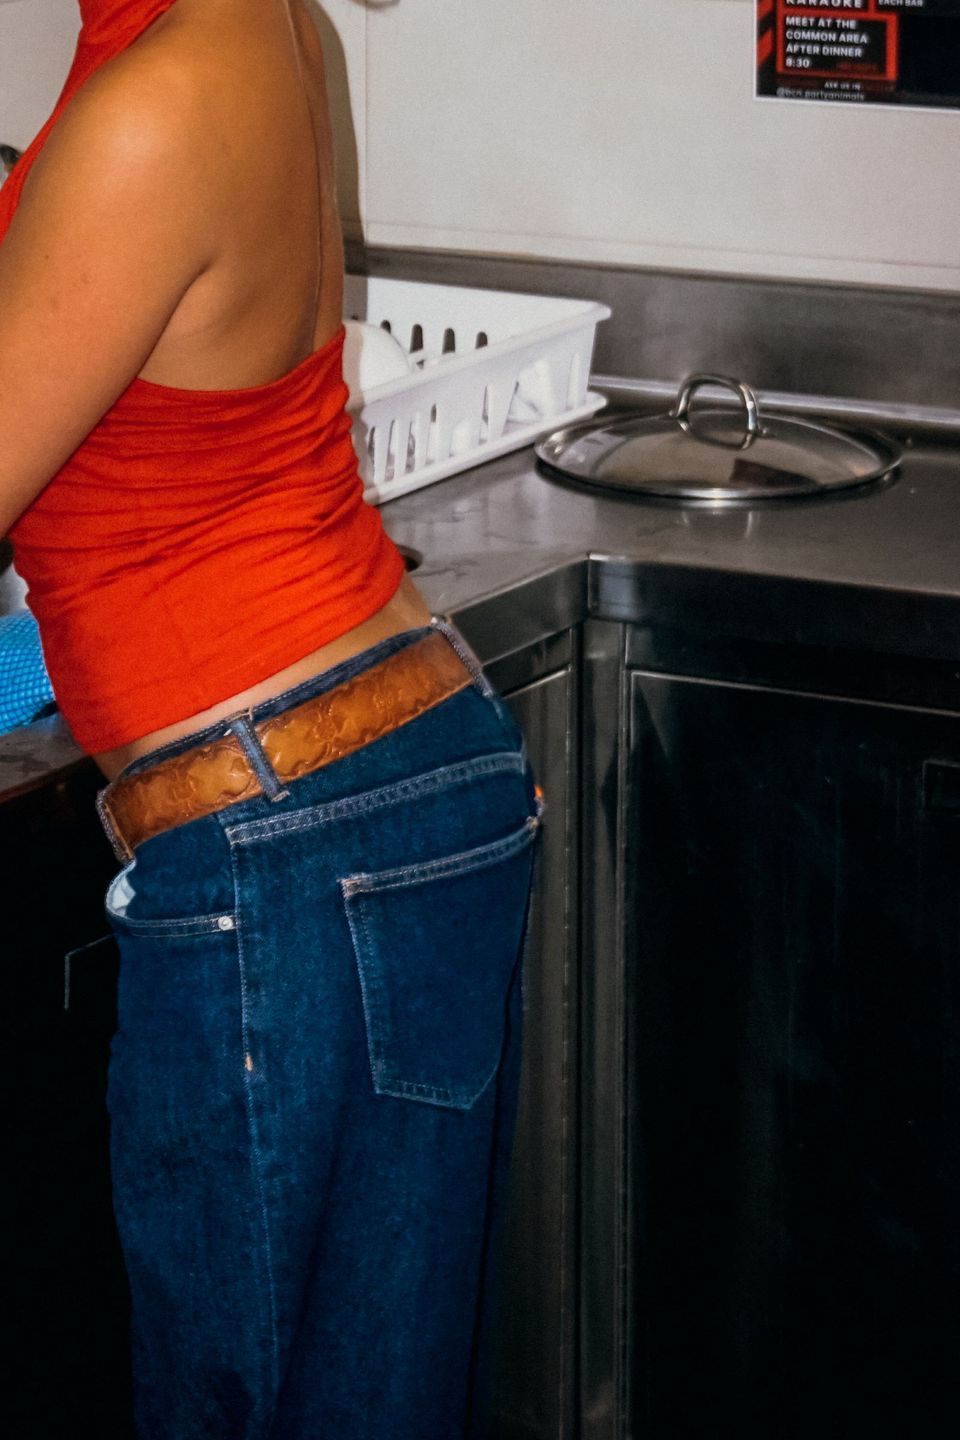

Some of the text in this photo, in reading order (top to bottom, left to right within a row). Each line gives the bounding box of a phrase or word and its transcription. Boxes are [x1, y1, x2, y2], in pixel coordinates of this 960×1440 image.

[785, 16, 857, 29] MEET AT THE
[785, 30, 868, 44] COMMON AREA
[785, 43, 862, 58] AFTER DINNER
